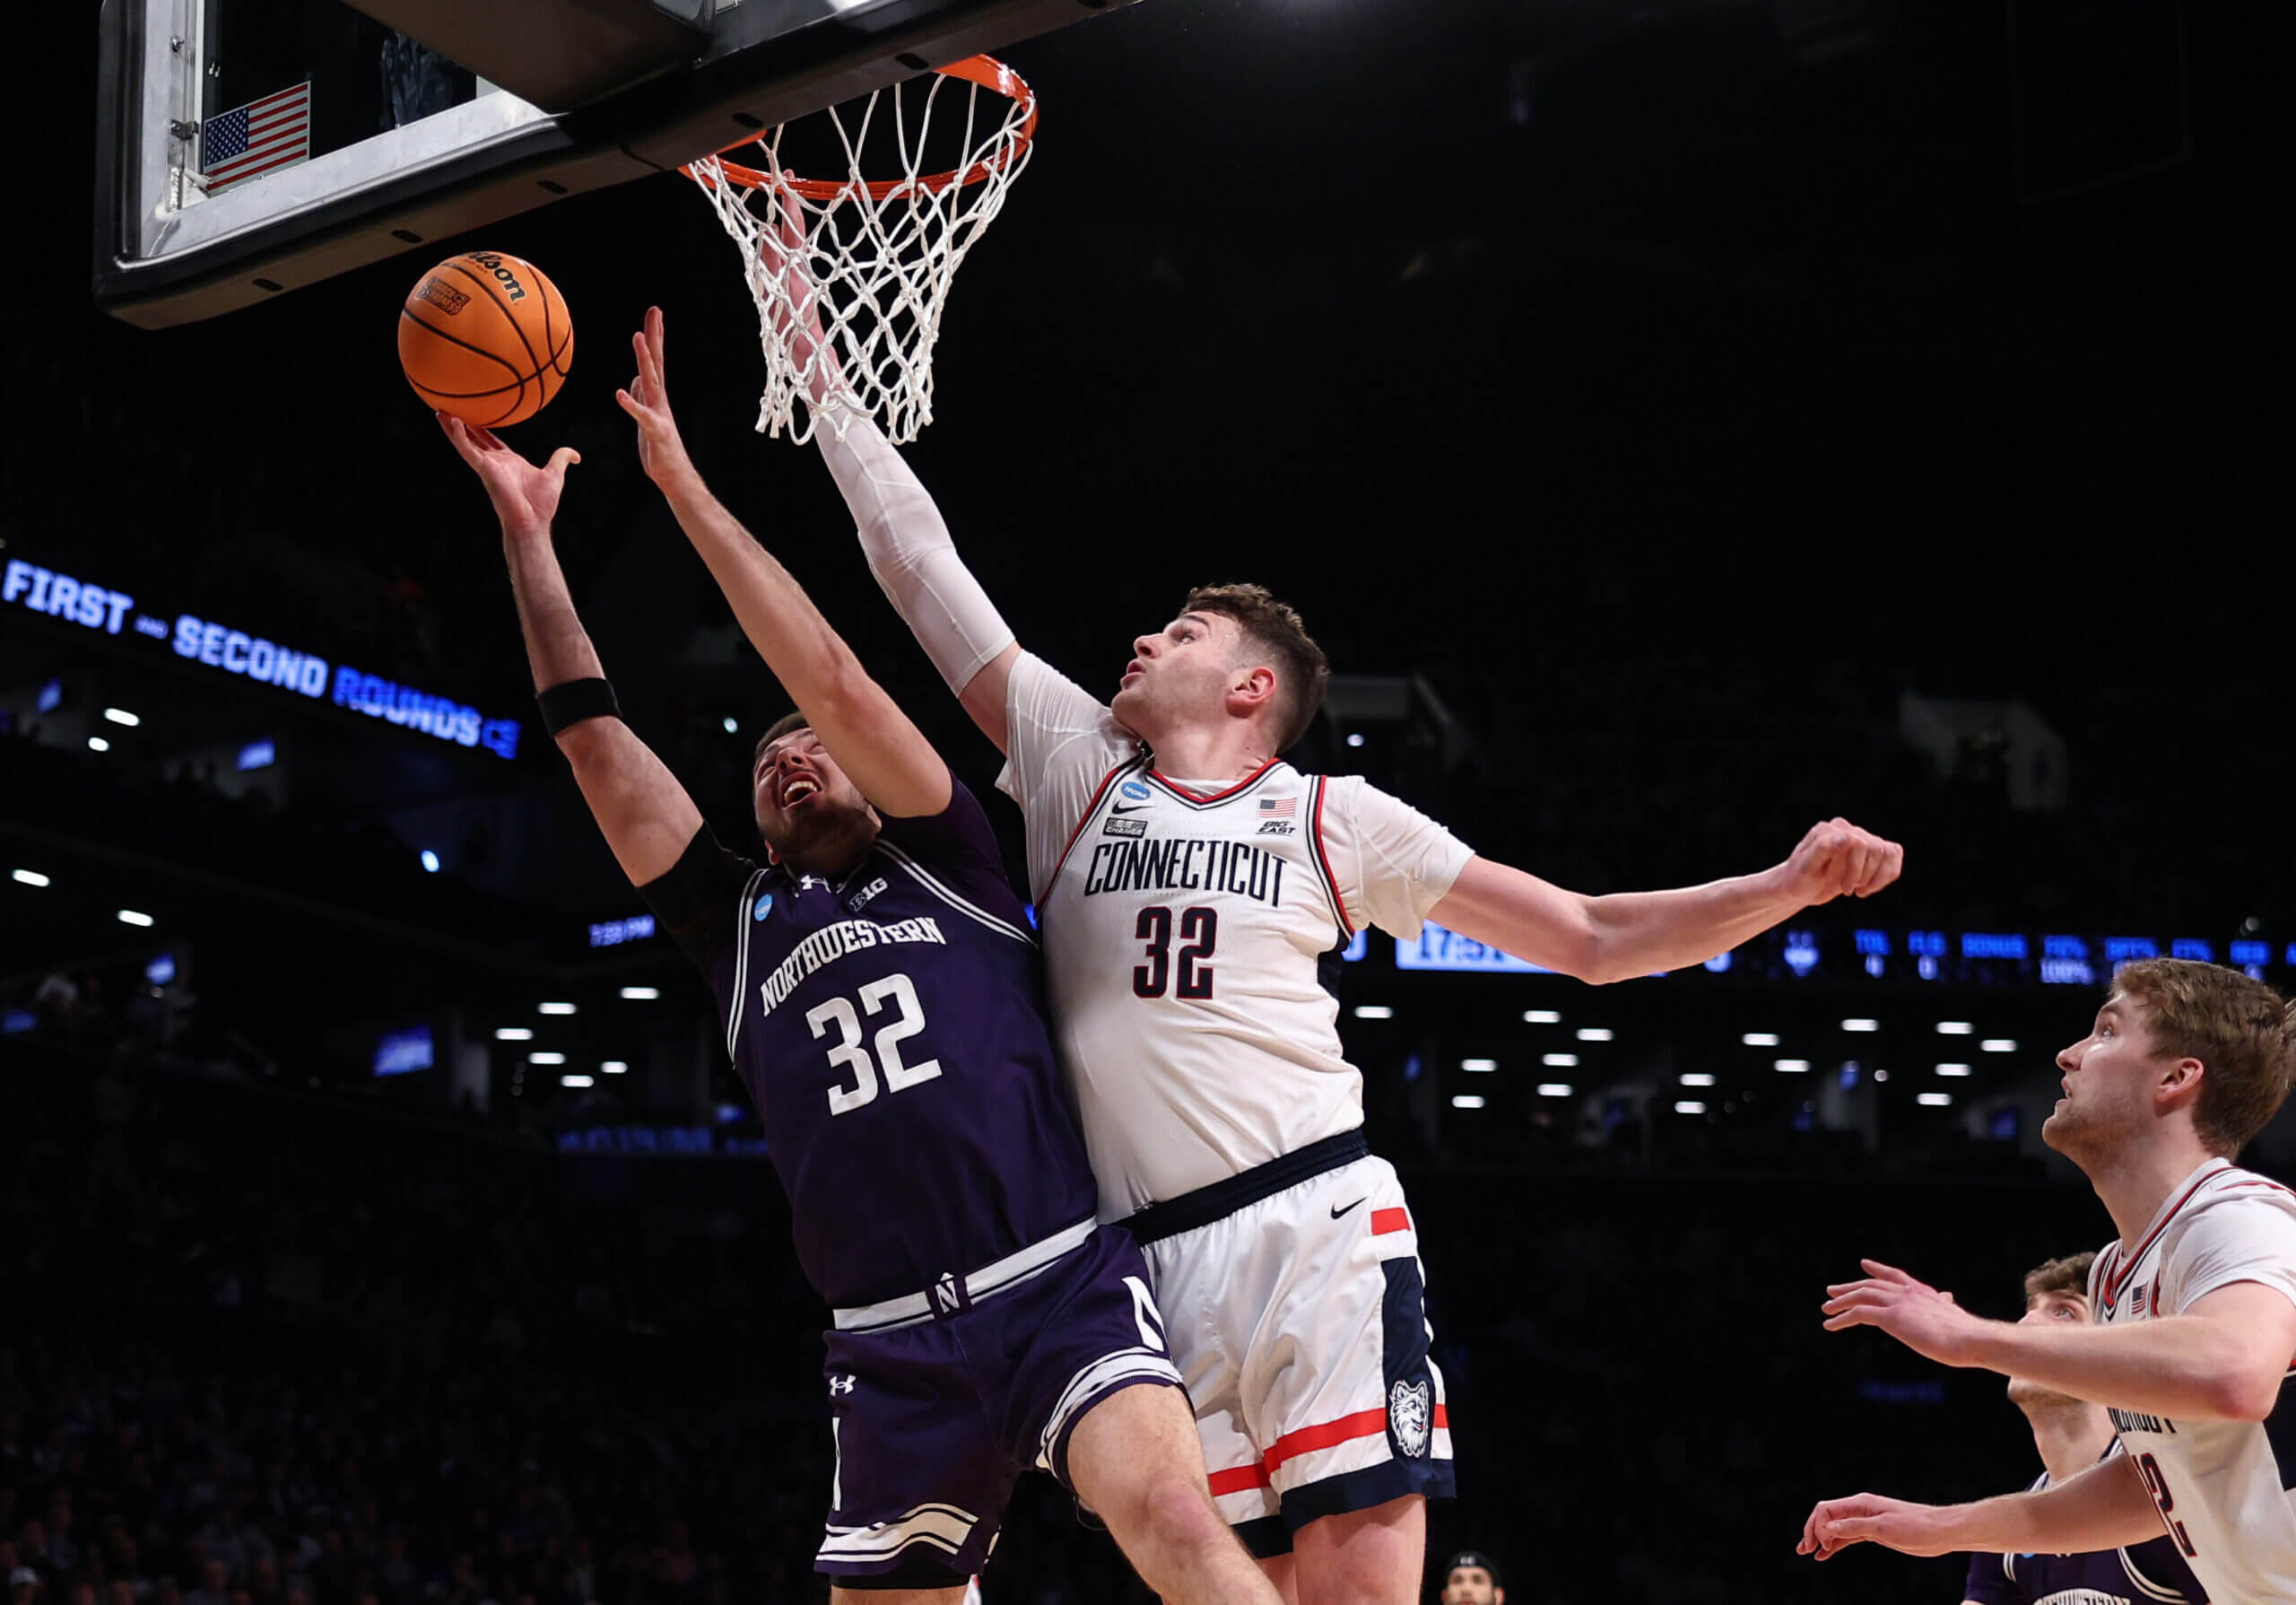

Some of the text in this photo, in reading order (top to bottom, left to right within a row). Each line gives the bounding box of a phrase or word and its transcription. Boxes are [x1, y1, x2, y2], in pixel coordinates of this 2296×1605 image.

[2, 557, 134, 635] FIRST
[172, 614, 328, 699] SECOND
[332, 664, 483, 747] ROUNDS
[1257, 826, 1297, 835] EAST
[1263, 820, 1290, 828] BIG
[1084, 839, 1287, 908] CONNECTICUT
[760, 916, 946, 1018] NORTHWESTERN
[1133, 906, 1218, 999] 32
[805, 973, 943, 1116] 32
